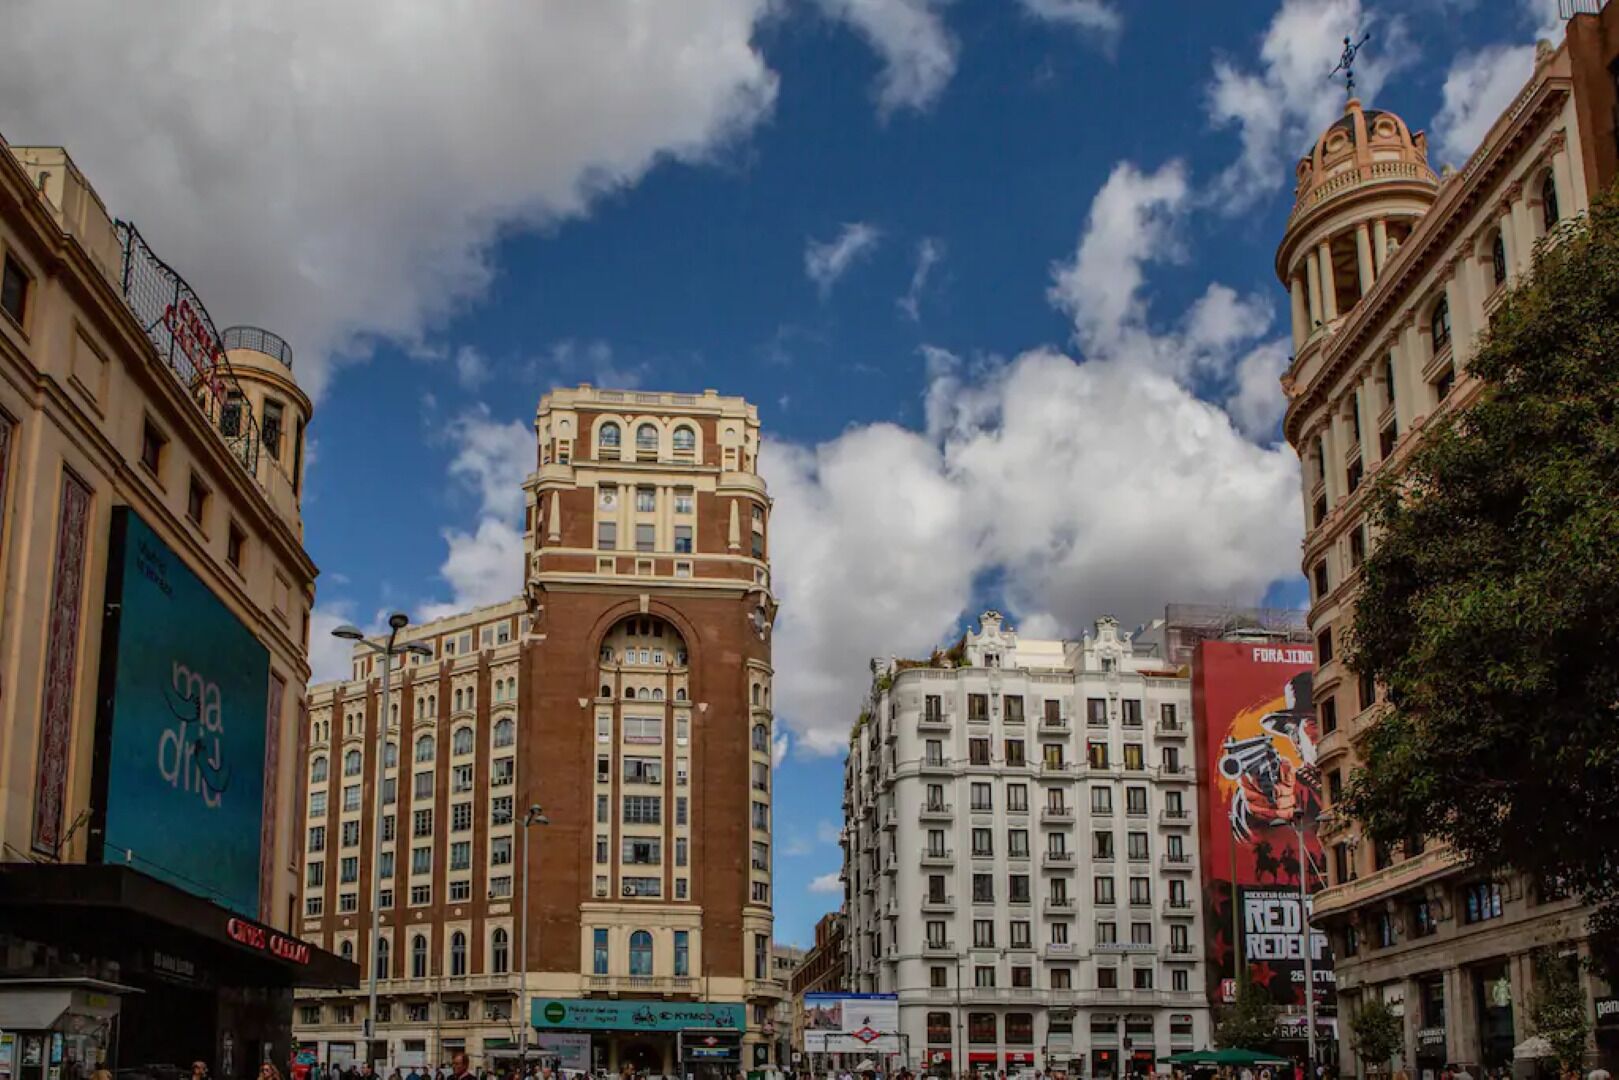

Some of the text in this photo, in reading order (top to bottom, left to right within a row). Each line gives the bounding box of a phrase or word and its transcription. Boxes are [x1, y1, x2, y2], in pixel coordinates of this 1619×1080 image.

[1245, 900, 1300, 933] RED
[1290, 969, 1337, 982] 26 CTU
[1417, 1028, 1446, 1038] STARBUCK
